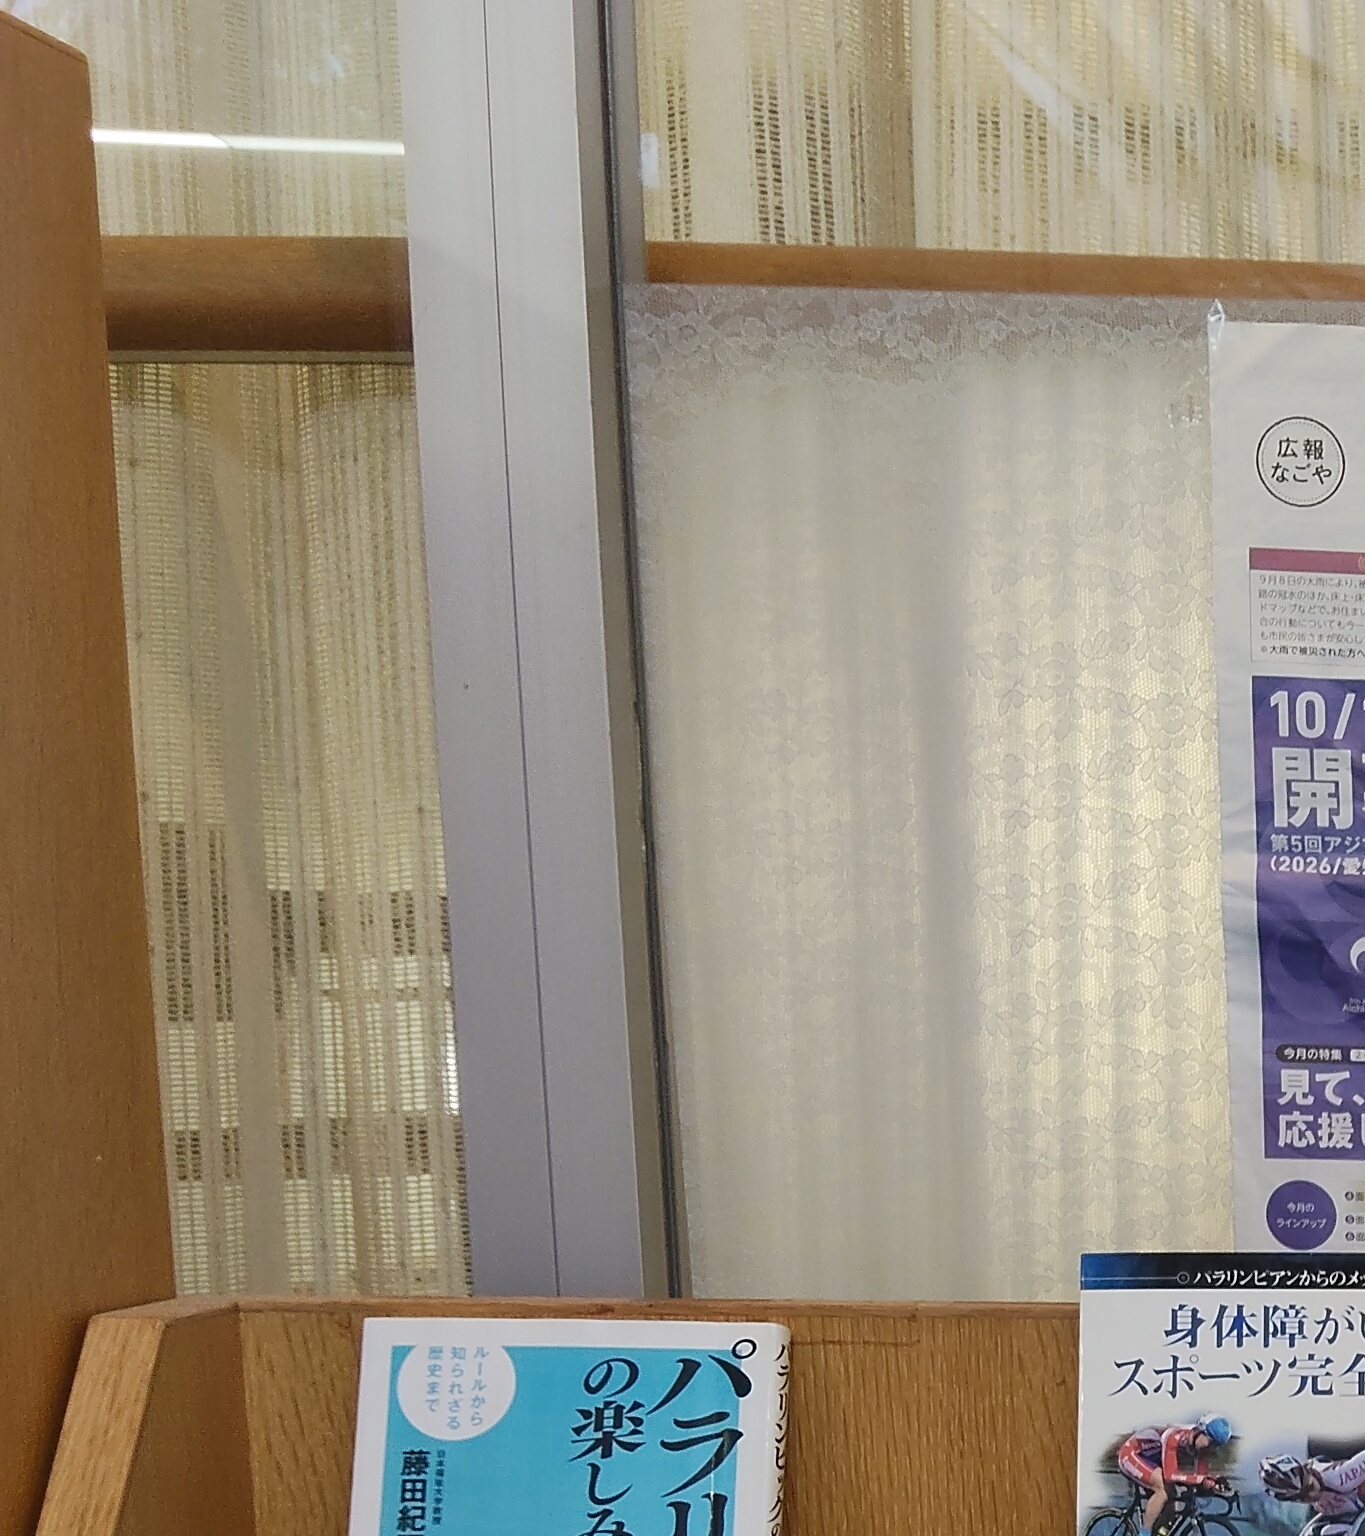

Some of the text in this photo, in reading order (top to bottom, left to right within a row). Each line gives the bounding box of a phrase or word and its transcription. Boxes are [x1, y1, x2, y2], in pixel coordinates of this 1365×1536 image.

[1277, 438, 1325, 461] 広報
[1271, 462, 1333, 485] なごや
[1283, 1047, 1343, 1061] 今月の特集
[1286, 1201, 1315, 1213] 今月の
[469, 1345, 491, 1427] ルールから
